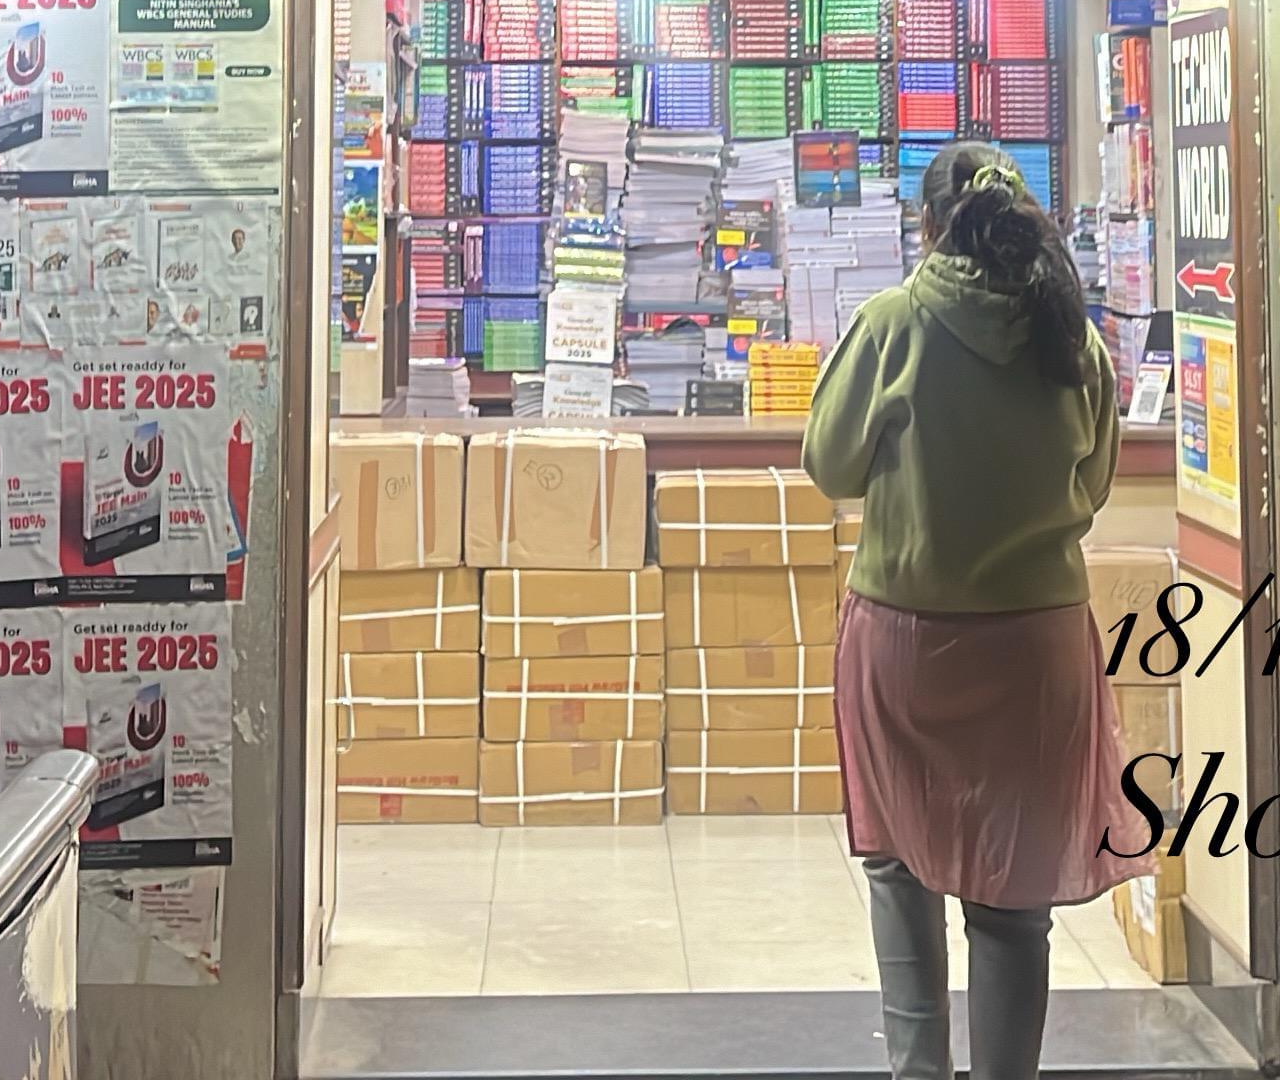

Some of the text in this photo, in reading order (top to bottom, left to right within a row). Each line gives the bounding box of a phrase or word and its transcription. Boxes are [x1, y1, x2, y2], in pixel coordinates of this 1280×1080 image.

[137, 9, 253, 19] WBCS GENERAL STUDIES
[174, 19, 216, 29] MANUAL
[123, 49, 163, 62] WBCS
[175, 49, 213, 62] WBCS
[51, 71, 64, 84] 10
[1172, 27, 1232, 128] TECHNO
[51, 107, 87, 122] 100%
[1178, 146, 1231, 240] WORLD
[552, 338, 608, 350] CAPSULE
[2, 367, 19, 377] for
[73, 361, 186, 372] Get set readdy for
[73, 374, 216, 410] JEE 2025
[9, 515, 46, 530] 100%
[169, 510, 205, 525] 100%
[4, 627, 21, 637] for
[74, 621, 188, 634] Get set readdy for
[74, 634, 218, 673] JEE 2025
[172, 773, 209, 788] 100%
